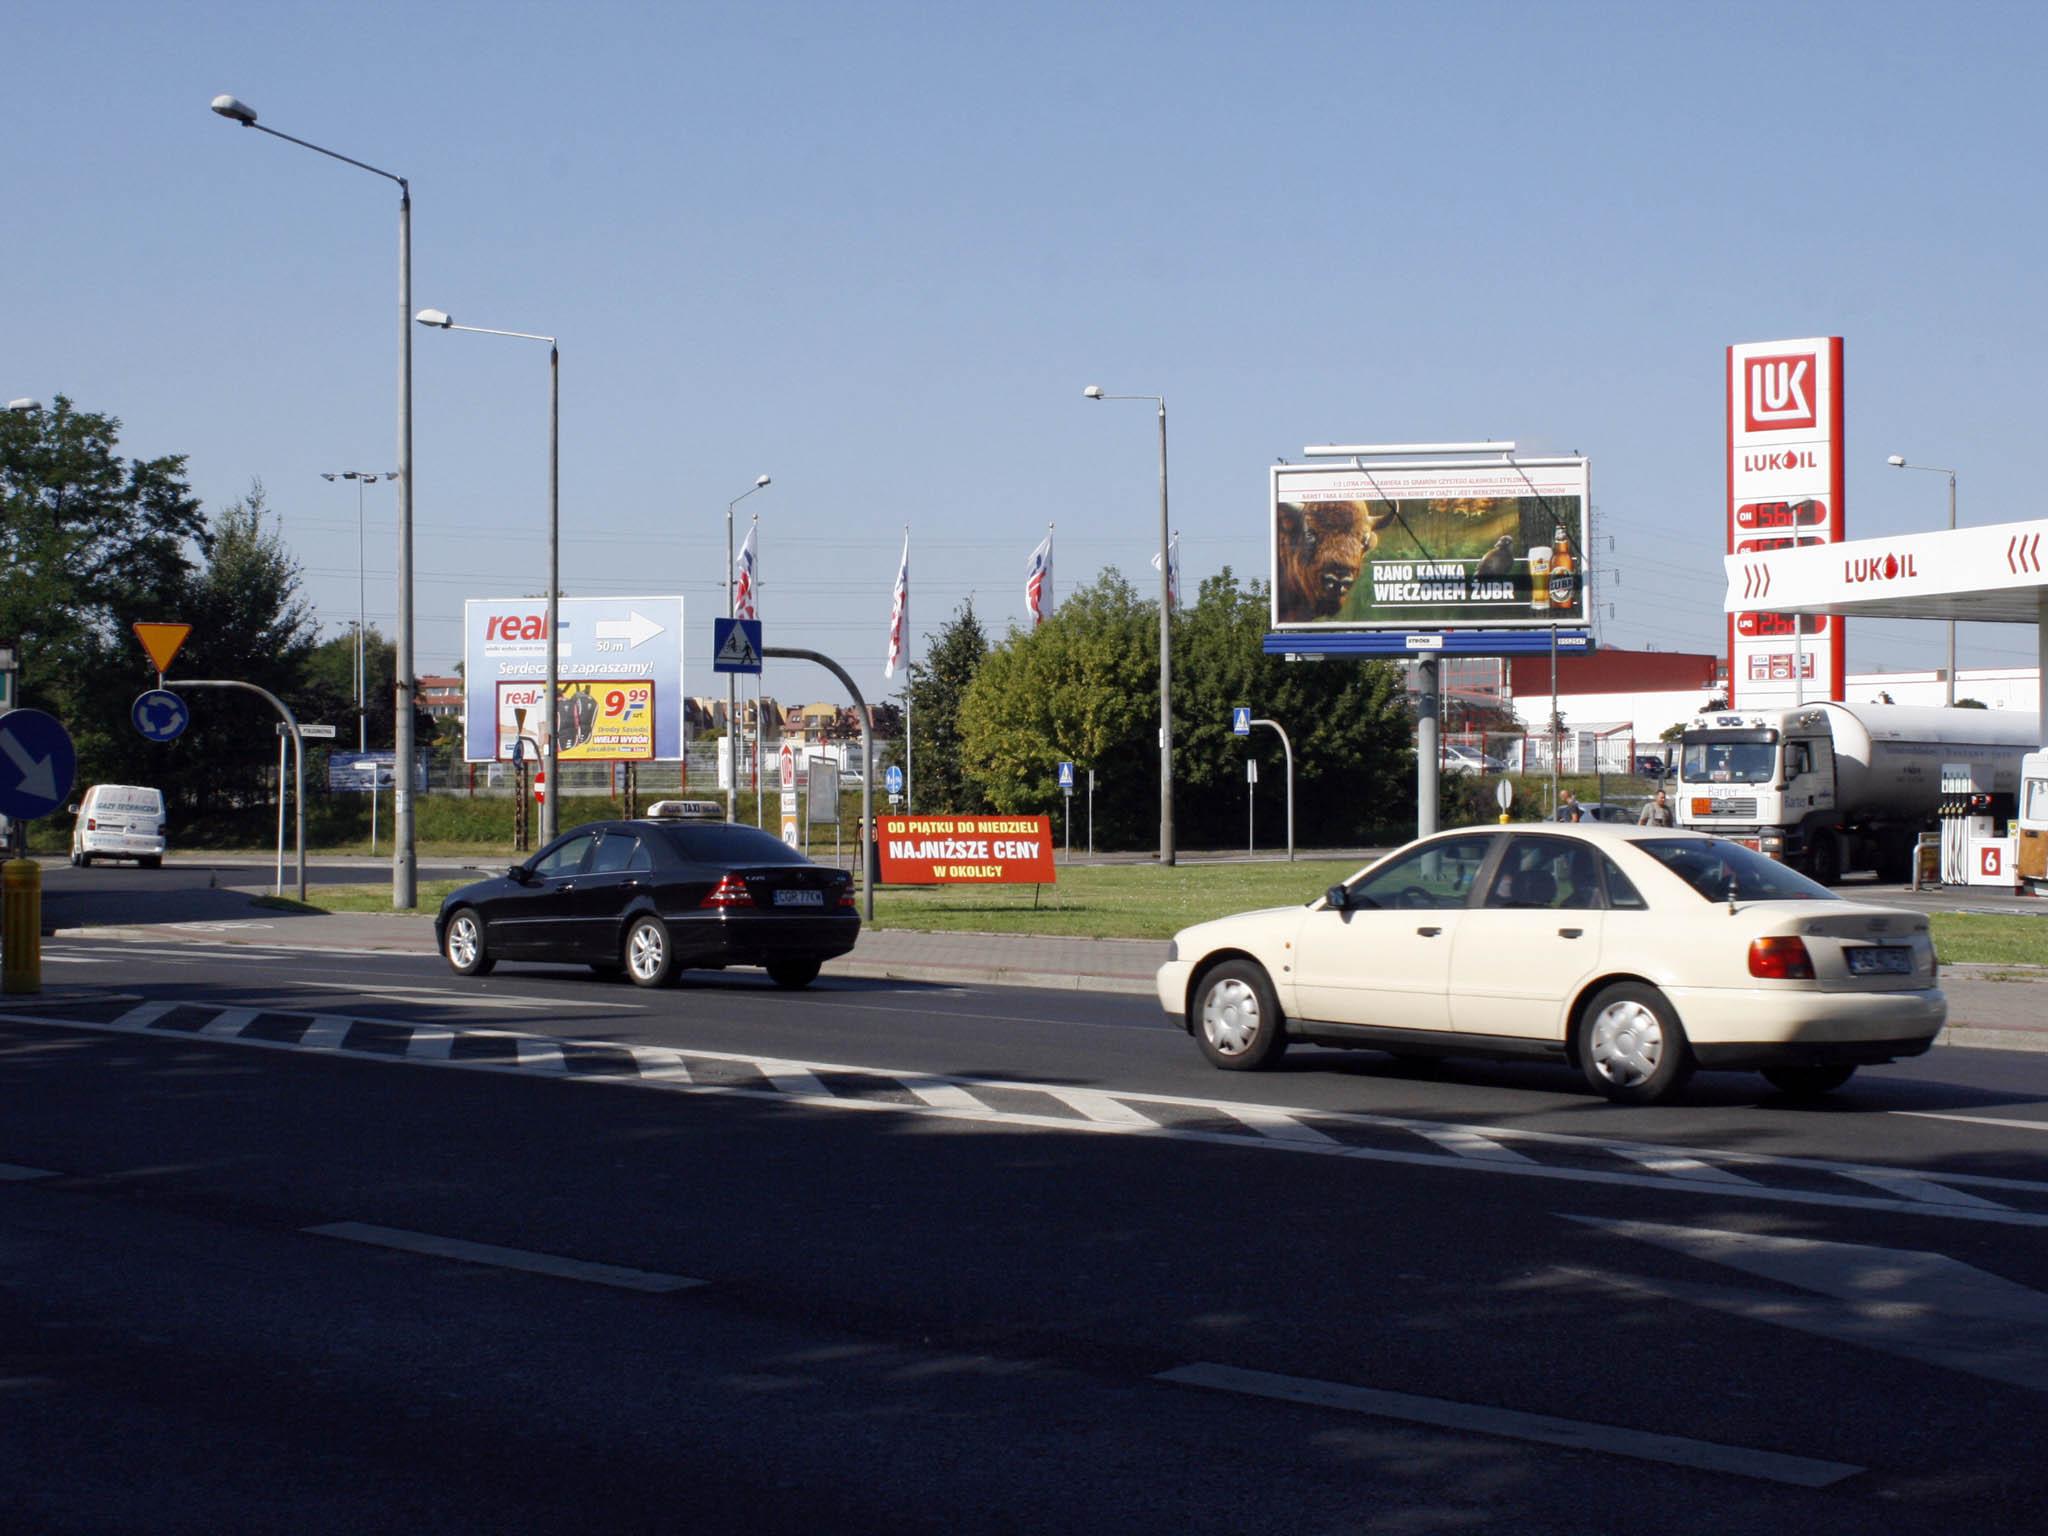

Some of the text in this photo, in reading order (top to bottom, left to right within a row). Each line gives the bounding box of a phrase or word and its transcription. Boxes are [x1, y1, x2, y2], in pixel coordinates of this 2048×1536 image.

[1745, 450, 1817, 472] LUKOIL
[1373, 564, 1466, 581] RANO KAWKA
[1845, 552, 1918, 583] LUKOIL
[1373, 578, 1515, 601] WIECZOREM ŻUBR
[596, 641, 624, 652] 50 m
[498, 660, 654, 676] Serdeczie zapraszamy!
[683, 803, 700, 813] TAXI
[888, 821, 1039, 835] OD PIĄTKU DO NIEDZIELI
[889, 838, 1040, 860] NAJNIŻSZE CENY
[1985, 851, 1998, 872] 6
[933, 865, 1002, 878] W OKOLICY
